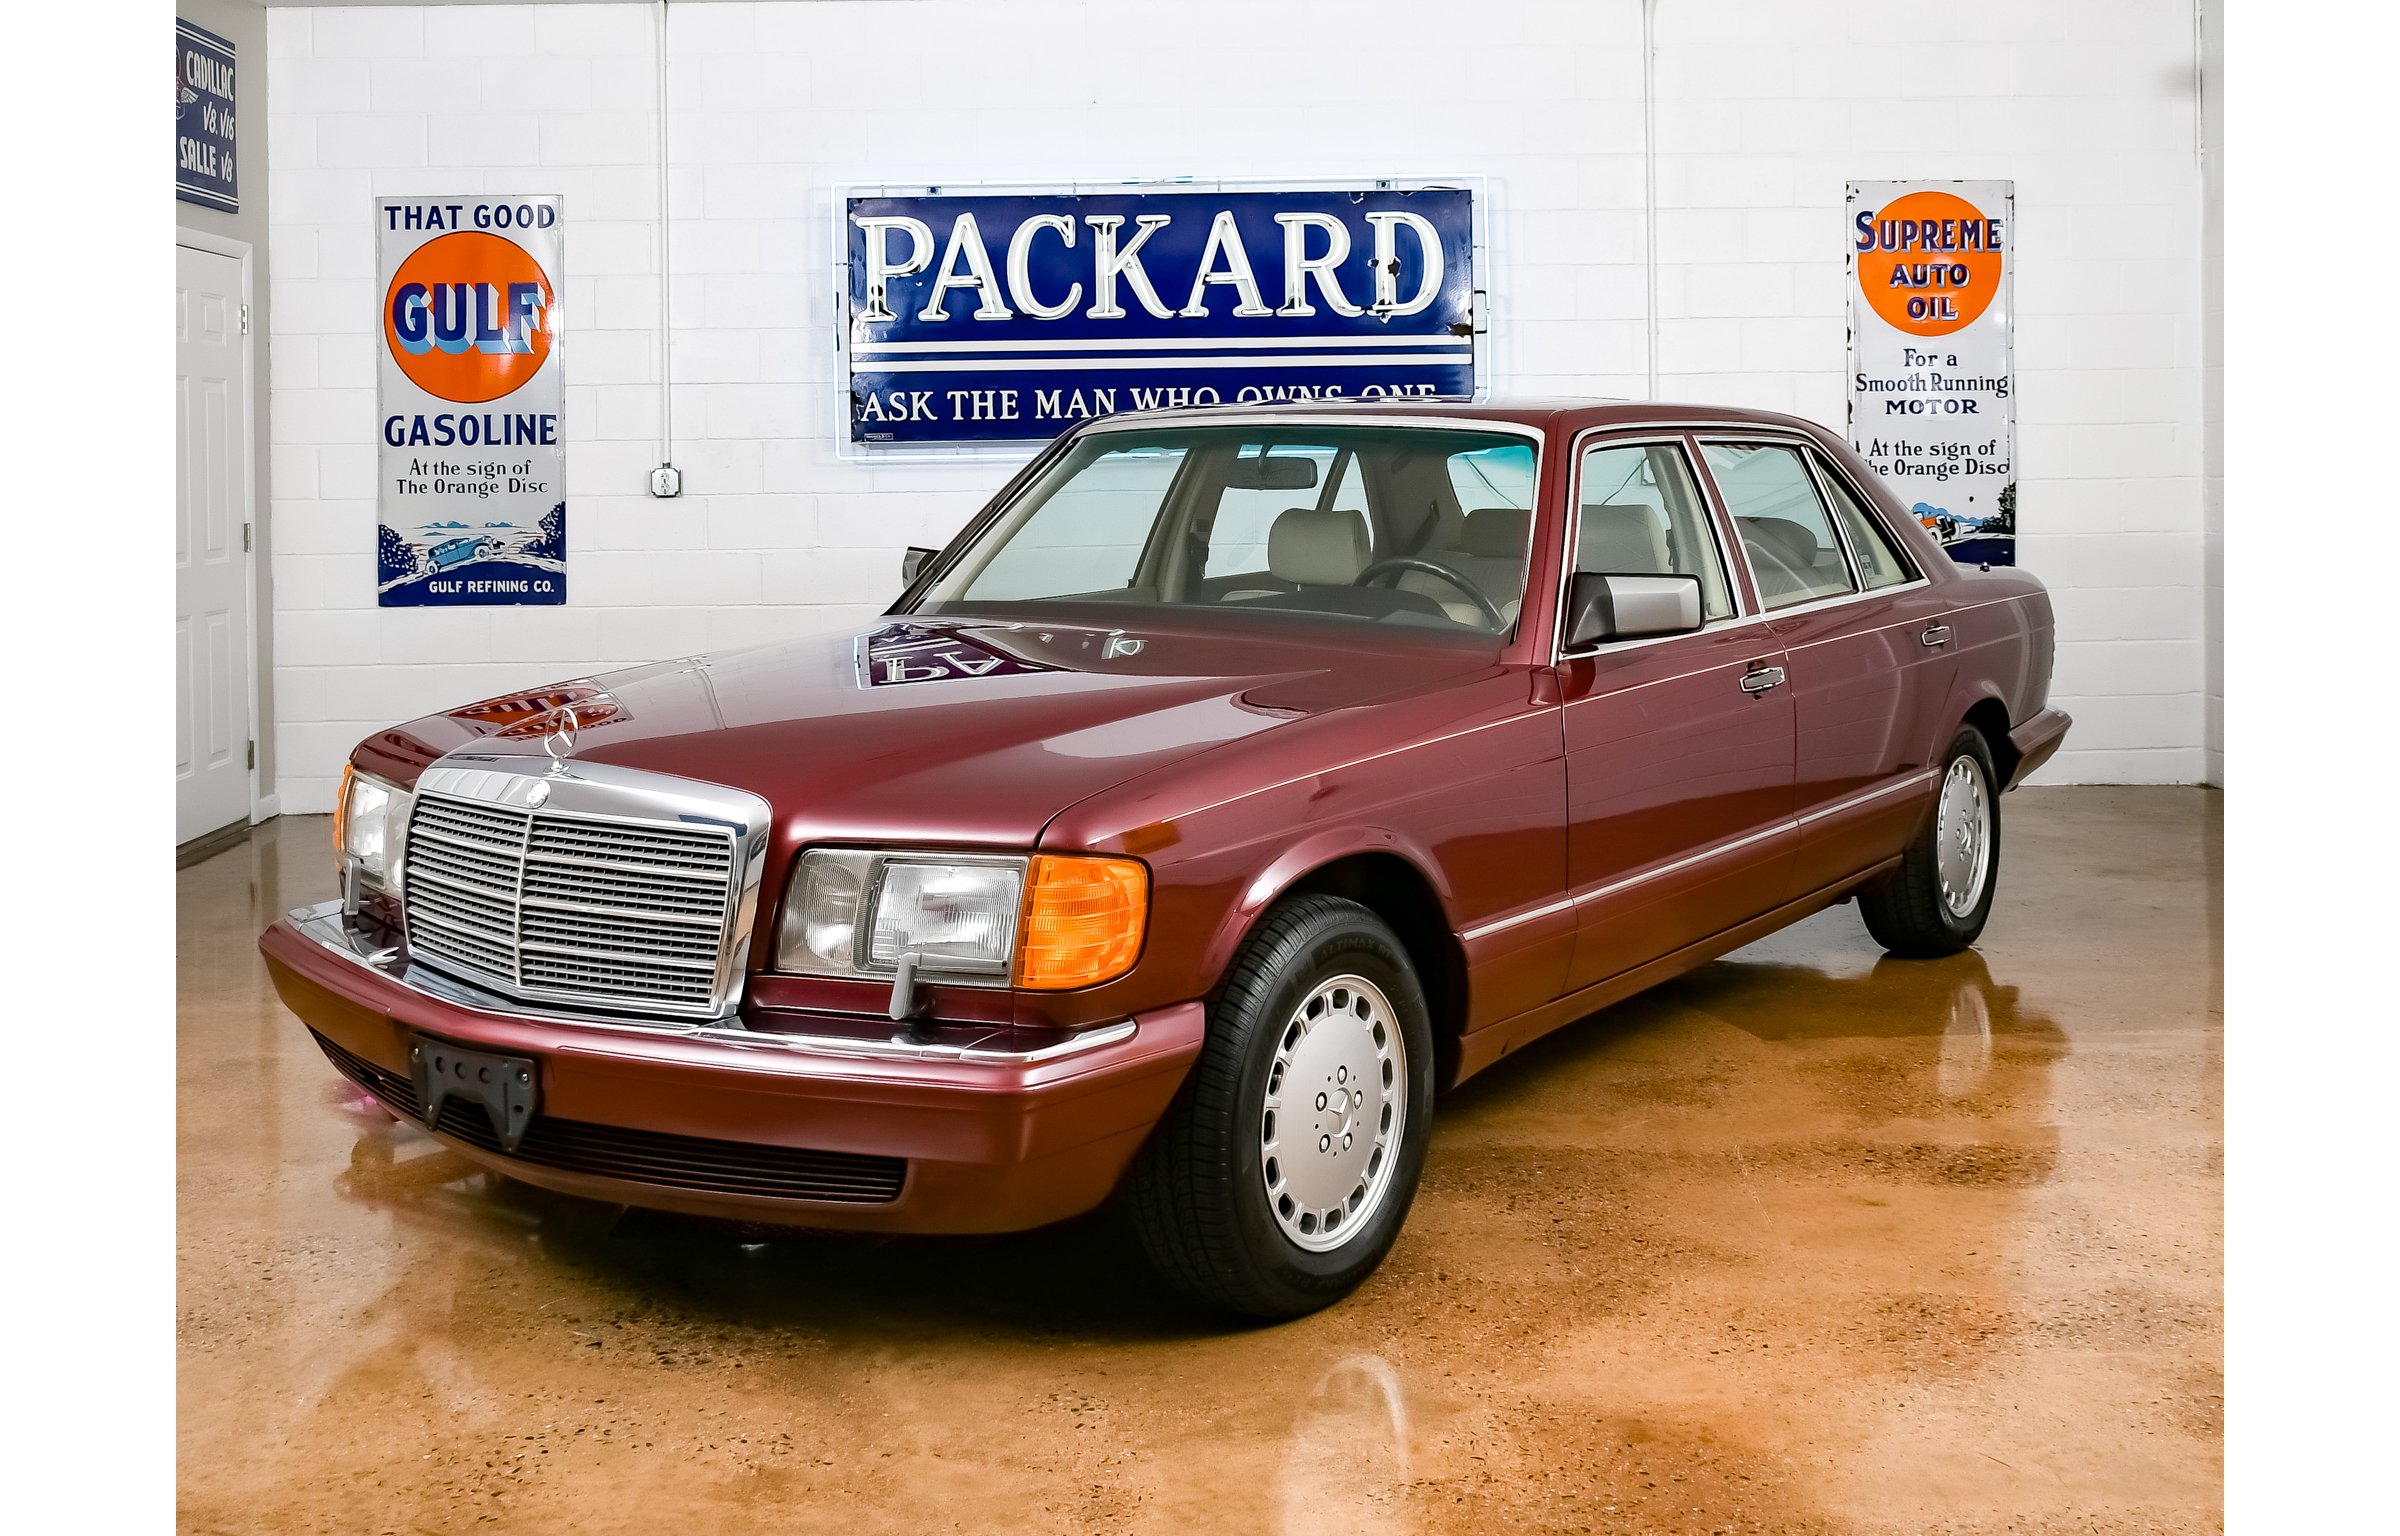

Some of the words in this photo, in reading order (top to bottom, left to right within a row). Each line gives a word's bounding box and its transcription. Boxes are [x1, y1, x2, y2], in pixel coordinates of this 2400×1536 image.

[186, 50, 235, 101] CADILLAC
[220, 107, 234, 141] V16
[180, 136, 217, 177] SALLE
[221, 151, 233, 183] V8
[384, 205, 463, 230] THAT
[474, 204, 555, 229] GOOD
[1855, 211, 2004, 253] SUPREME
[855, 210, 1446, 323] PACKARD
[1889, 264, 1971, 288] AUTO
[392, 282, 547, 354] GULF
[1907, 297, 1959, 321] OIL
[1904, 349, 1939, 367] For
[1946, 354, 1959, 367] a
[1856, 373, 1926, 392] Smooth
[1930, 373, 2009, 398] Running
[861, 391, 938, 422] ASK
[947, 389, 1019, 420] THE
[1035, 388, 1117, 419] MAN
[1129, 387, 1220, 410] WHO
[1885, 399, 1980, 414] MOTOR
[384, 414, 557, 447] GASOLINE
[1869, 438, 1889, 456] At
[1894, 440, 1923, 456] the
[1929, 442, 1972, 460] sign
[1978, 440, 1996, 456] of
[409, 458, 429, 475] At
[433, 460, 461, 475] the
[466, 461, 507, 479] sign
[512, 459, 532, 475] of
[1865, 459, 1889, 476] he
[1894, 459, 1960, 481] Orange
[1965, 458, 2009, 475] Disc
[396, 479, 428, 494] The
[434, 478, 499, 499] Orange
[508, 478, 549, 493] Disc
[429, 581, 463, 593] GULF
[467, 580, 529, 593] REFINING
[533, 580, 555, 593] CO.
